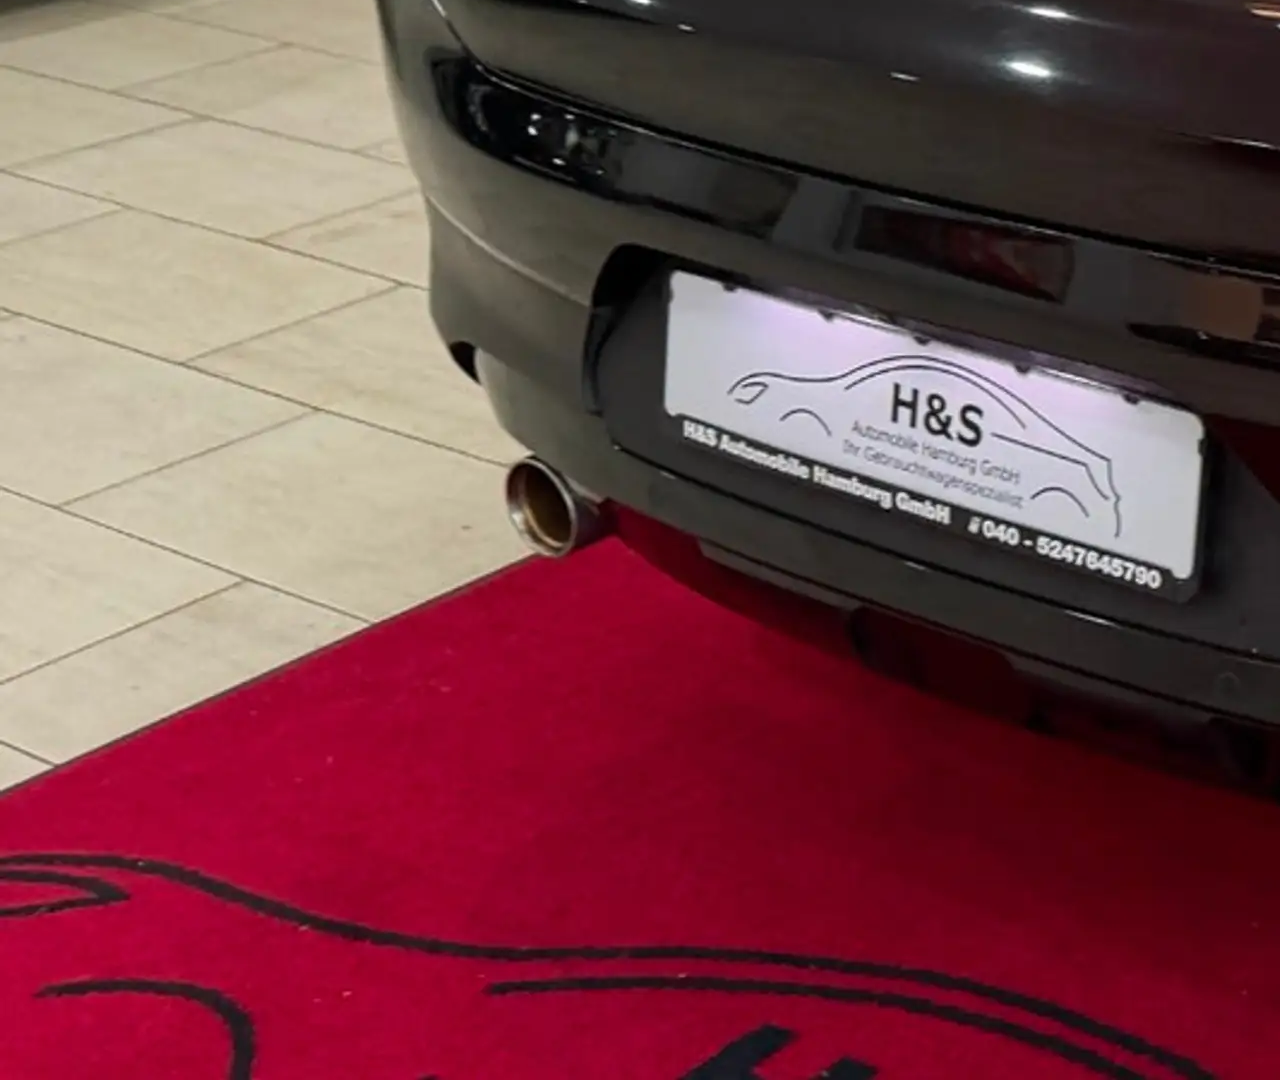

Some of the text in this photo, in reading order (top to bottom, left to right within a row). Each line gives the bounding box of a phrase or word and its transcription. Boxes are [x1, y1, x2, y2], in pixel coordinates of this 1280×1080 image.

[890, 381, 984, 447] H&S
[851, 420, 1021, 485] Automobile Hamburg GmbH
[683, 419, 717, 448] H&S
[718, 432, 810, 480] Automobile
[812, 465, 893, 510] Hamburg
[895, 491, 951, 525] GmbH
[1036, 534, 1163, 590] 5247645790
